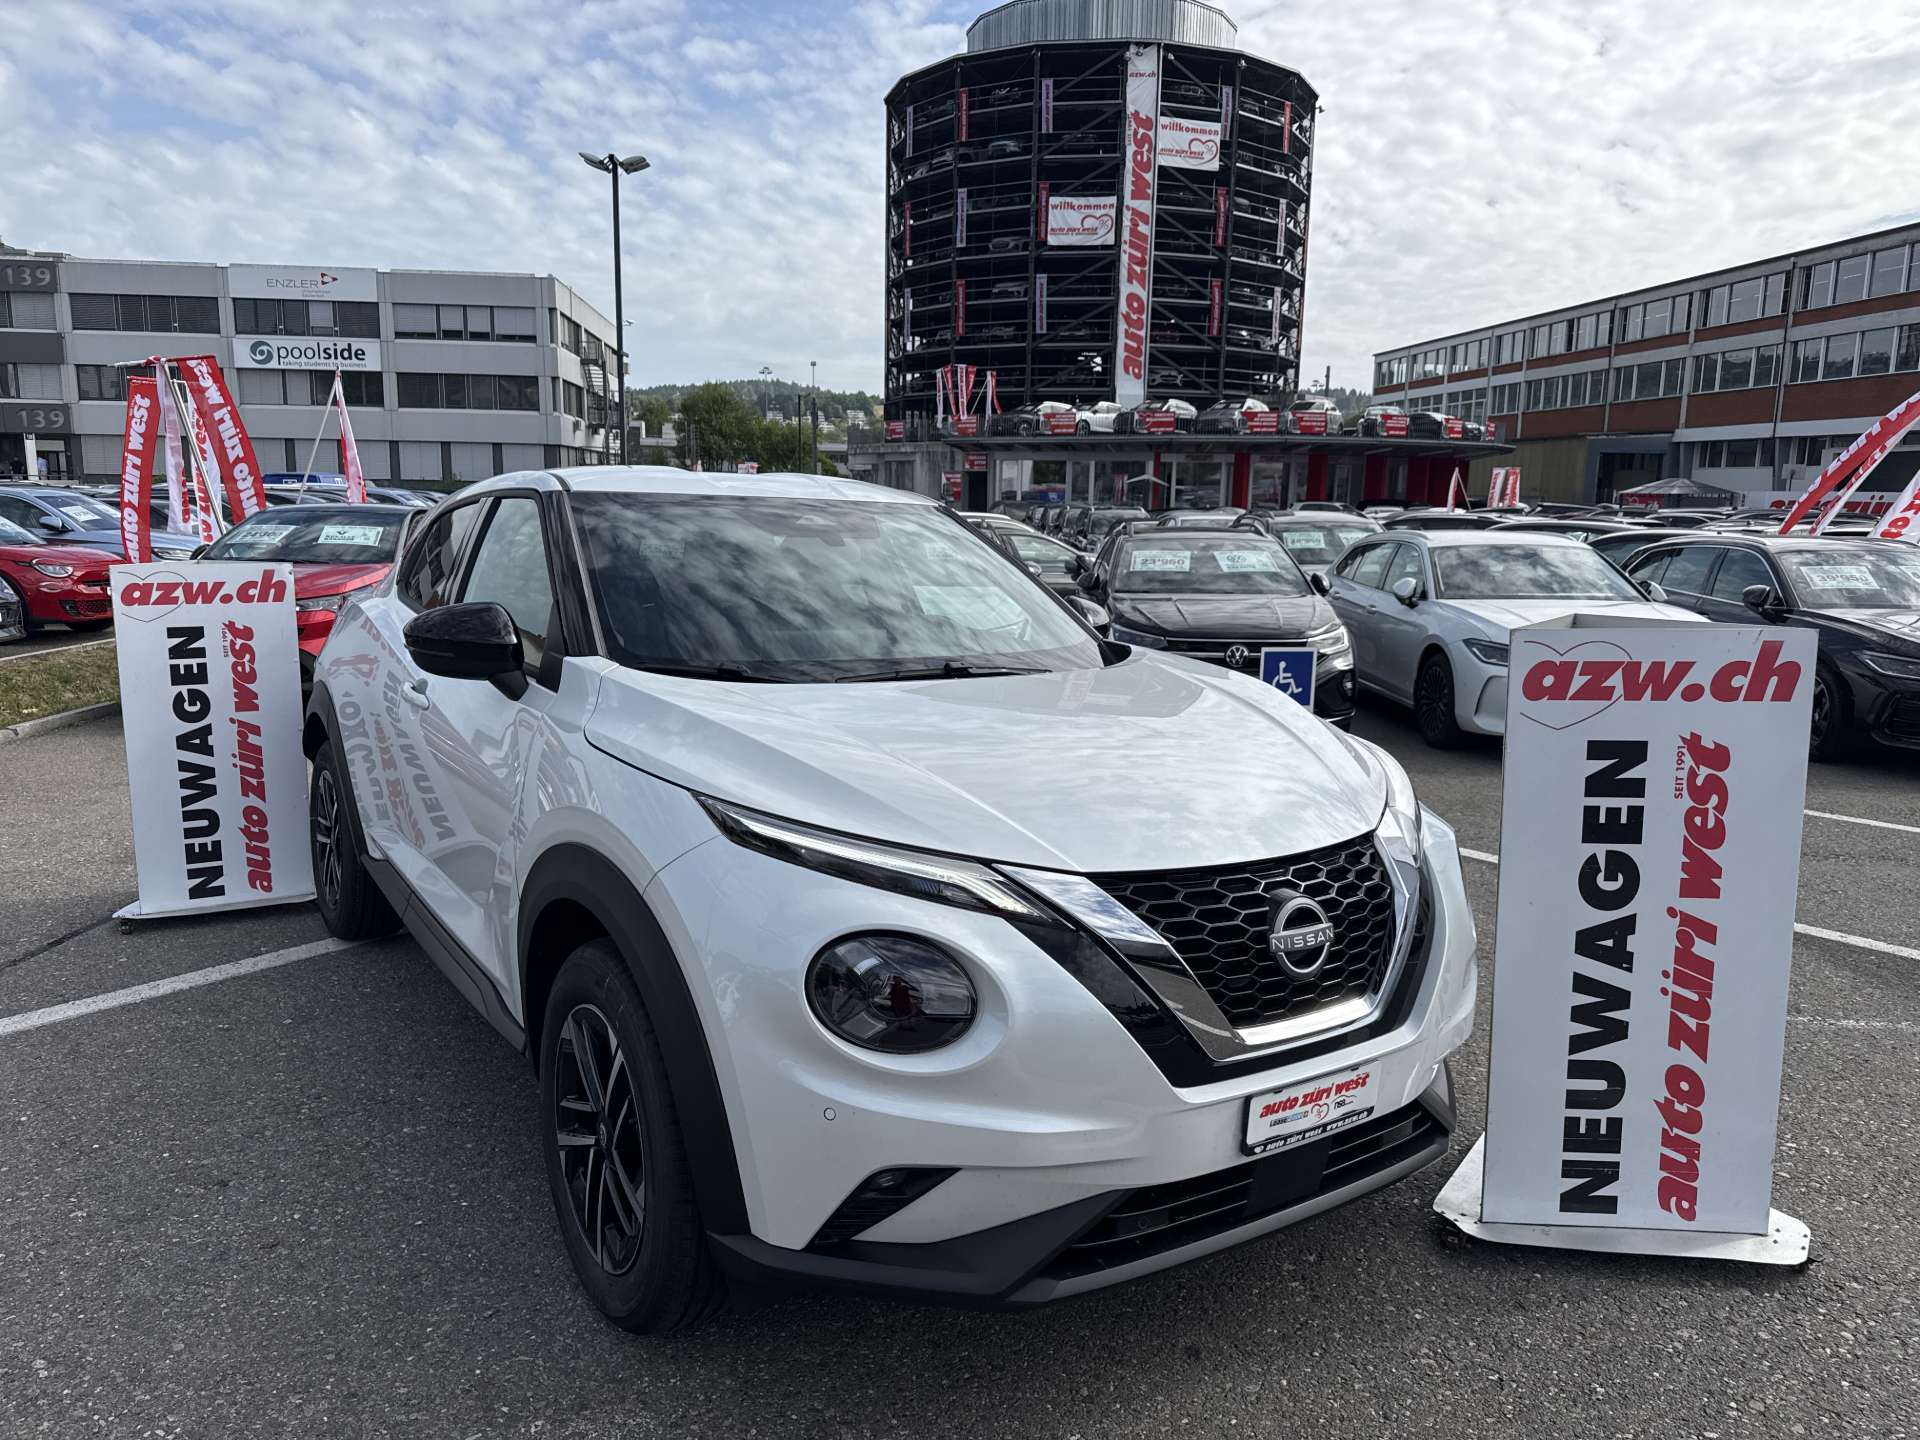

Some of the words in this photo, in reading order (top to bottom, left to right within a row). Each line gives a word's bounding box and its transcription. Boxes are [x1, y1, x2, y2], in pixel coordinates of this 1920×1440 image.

[1129, 70, 1157, 79] azw.ch
[1130, 110, 1153, 201] west
[1160, 121, 1219, 136] willkommen
[1050, 200, 1115, 211] willkommen
[1122, 205, 1150, 291] züri
[2, 266, 51, 287] 139
[265, 277, 319, 289] ENZLER
[276, 341, 366, 366] poolside
[1121, 292, 1145, 380] auto
[282, 360, 303, 369] taking
[304, 360, 331, 368] students
[16, 409, 65, 429] 139
[128, 393, 151, 451] west
[122, 450, 142, 504] züri
[120, 569, 287, 607] azw.ch
[222, 619, 260, 713] west
[1521, 640, 1802, 703] azw.ch
[166, 625, 226, 900] NEUWAGEN
[229, 716, 267, 804] züri
[1675, 743, 1686, 772] 1991
[1674, 774, 1684, 800] SEIT
[1678, 731, 1731, 899] west
[238, 804, 273, 894] auto
[1271, 927, 1334, 950] NISSAN
[1559, 739, 1649, 1215] NEUWAGEN
[1660, 905, 1718, 1064] züri
[1260, 1094, 1299, 1118] auto
[1299, 1082, 1335, 1107] züri
[1334, 1071, 1370, 1096] west
[1653, 1063, 1706, 1222] auto
